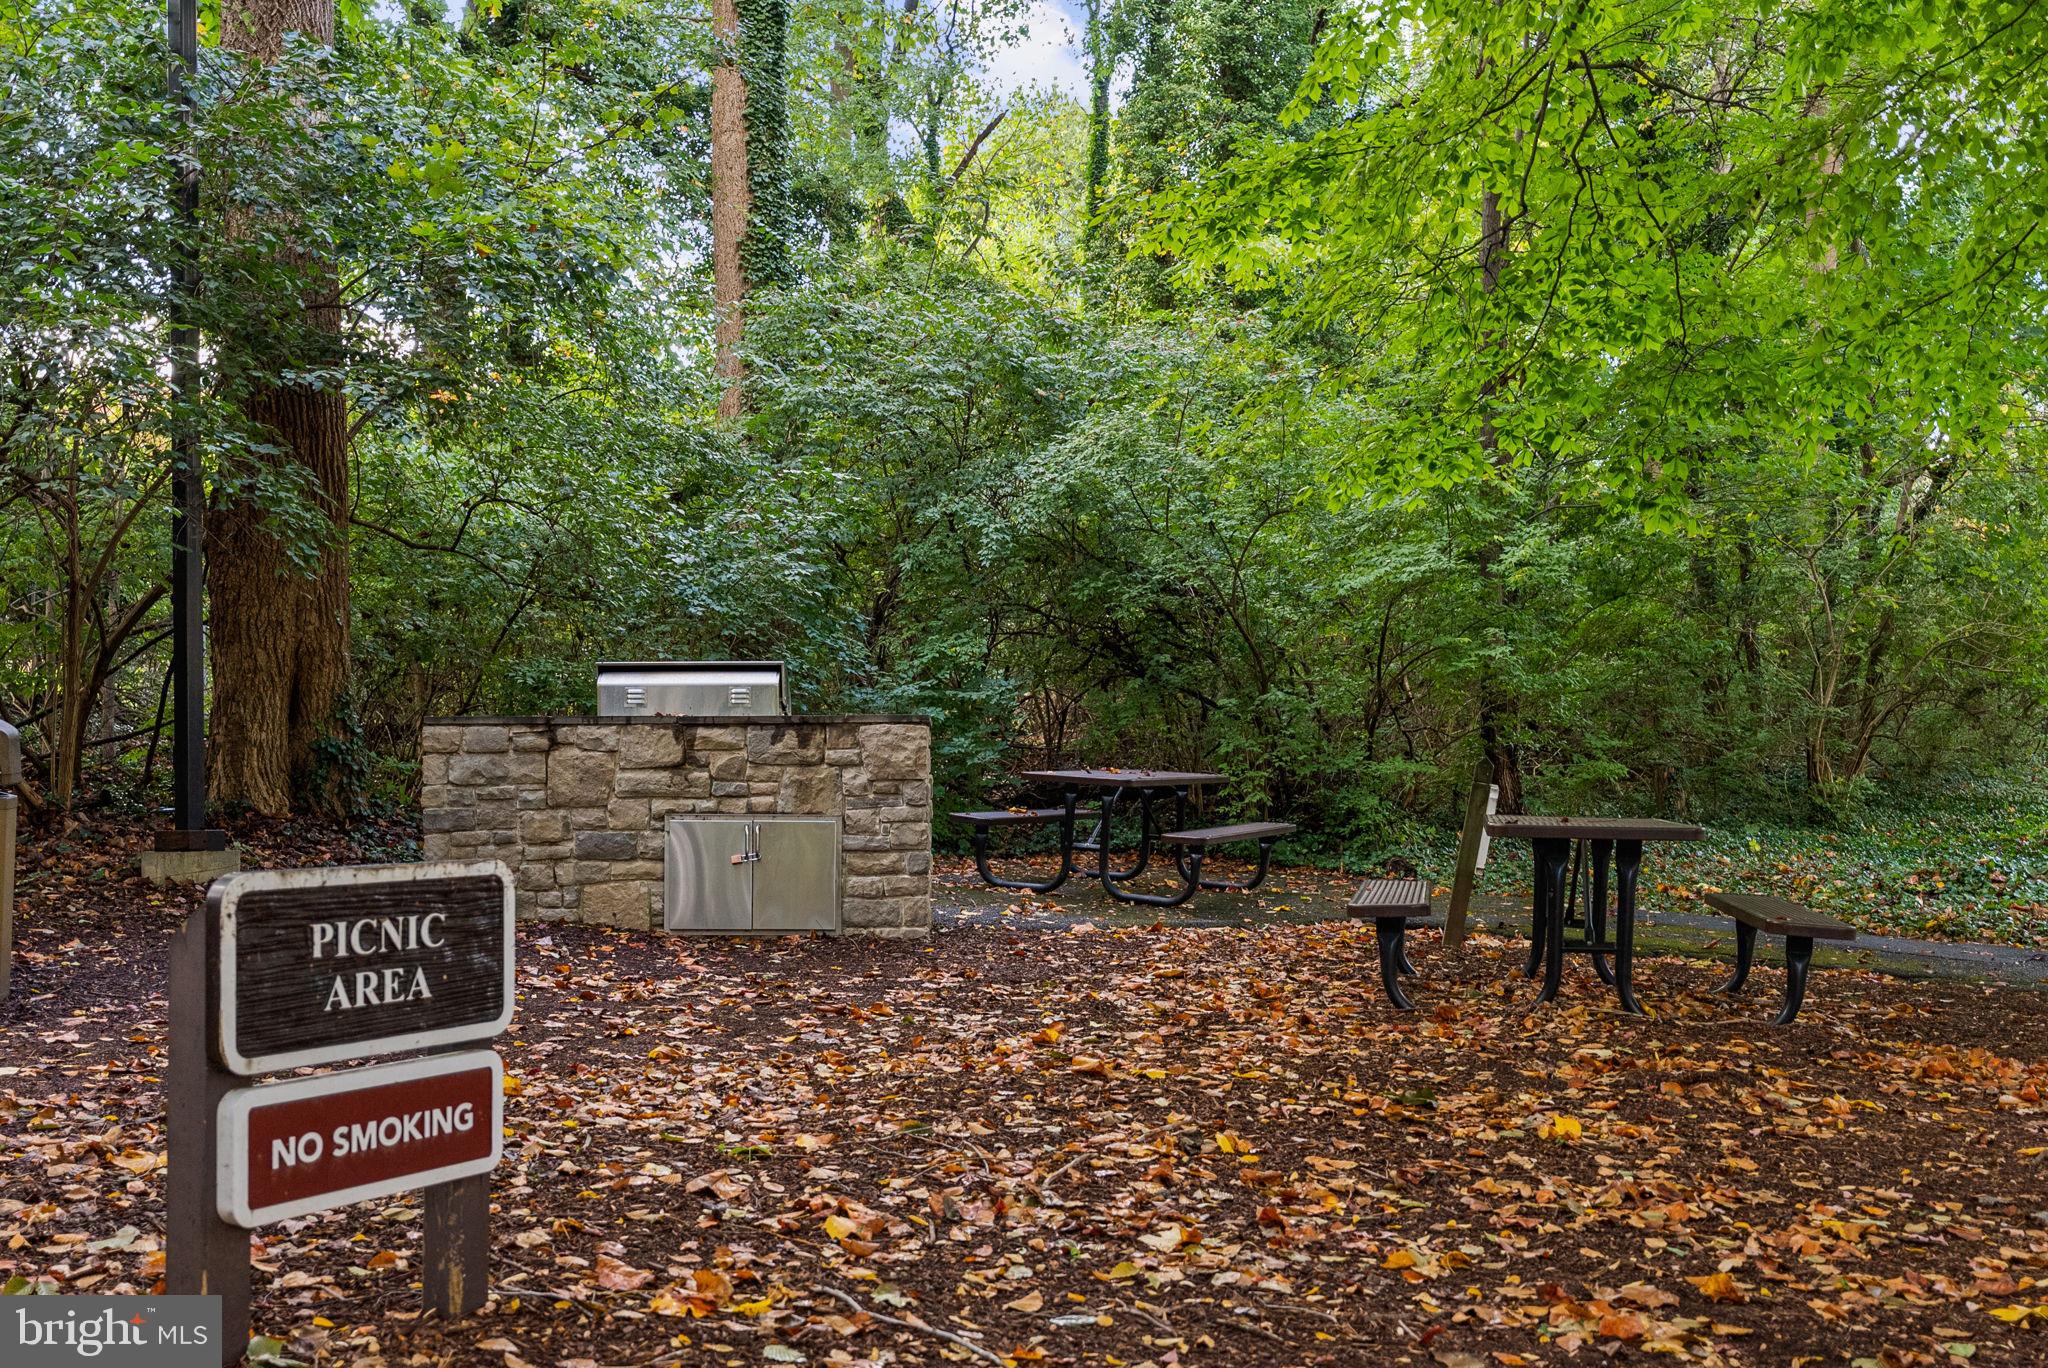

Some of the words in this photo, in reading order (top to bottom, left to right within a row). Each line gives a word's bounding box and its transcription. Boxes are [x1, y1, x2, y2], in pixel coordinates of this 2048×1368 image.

[310, 913, 446, 958] PICNIC
[324, 966, 433, 1011] AREA
[271, 1132, 323, 1170] NO
[332, 1102, 474, 1157] SMOKING
